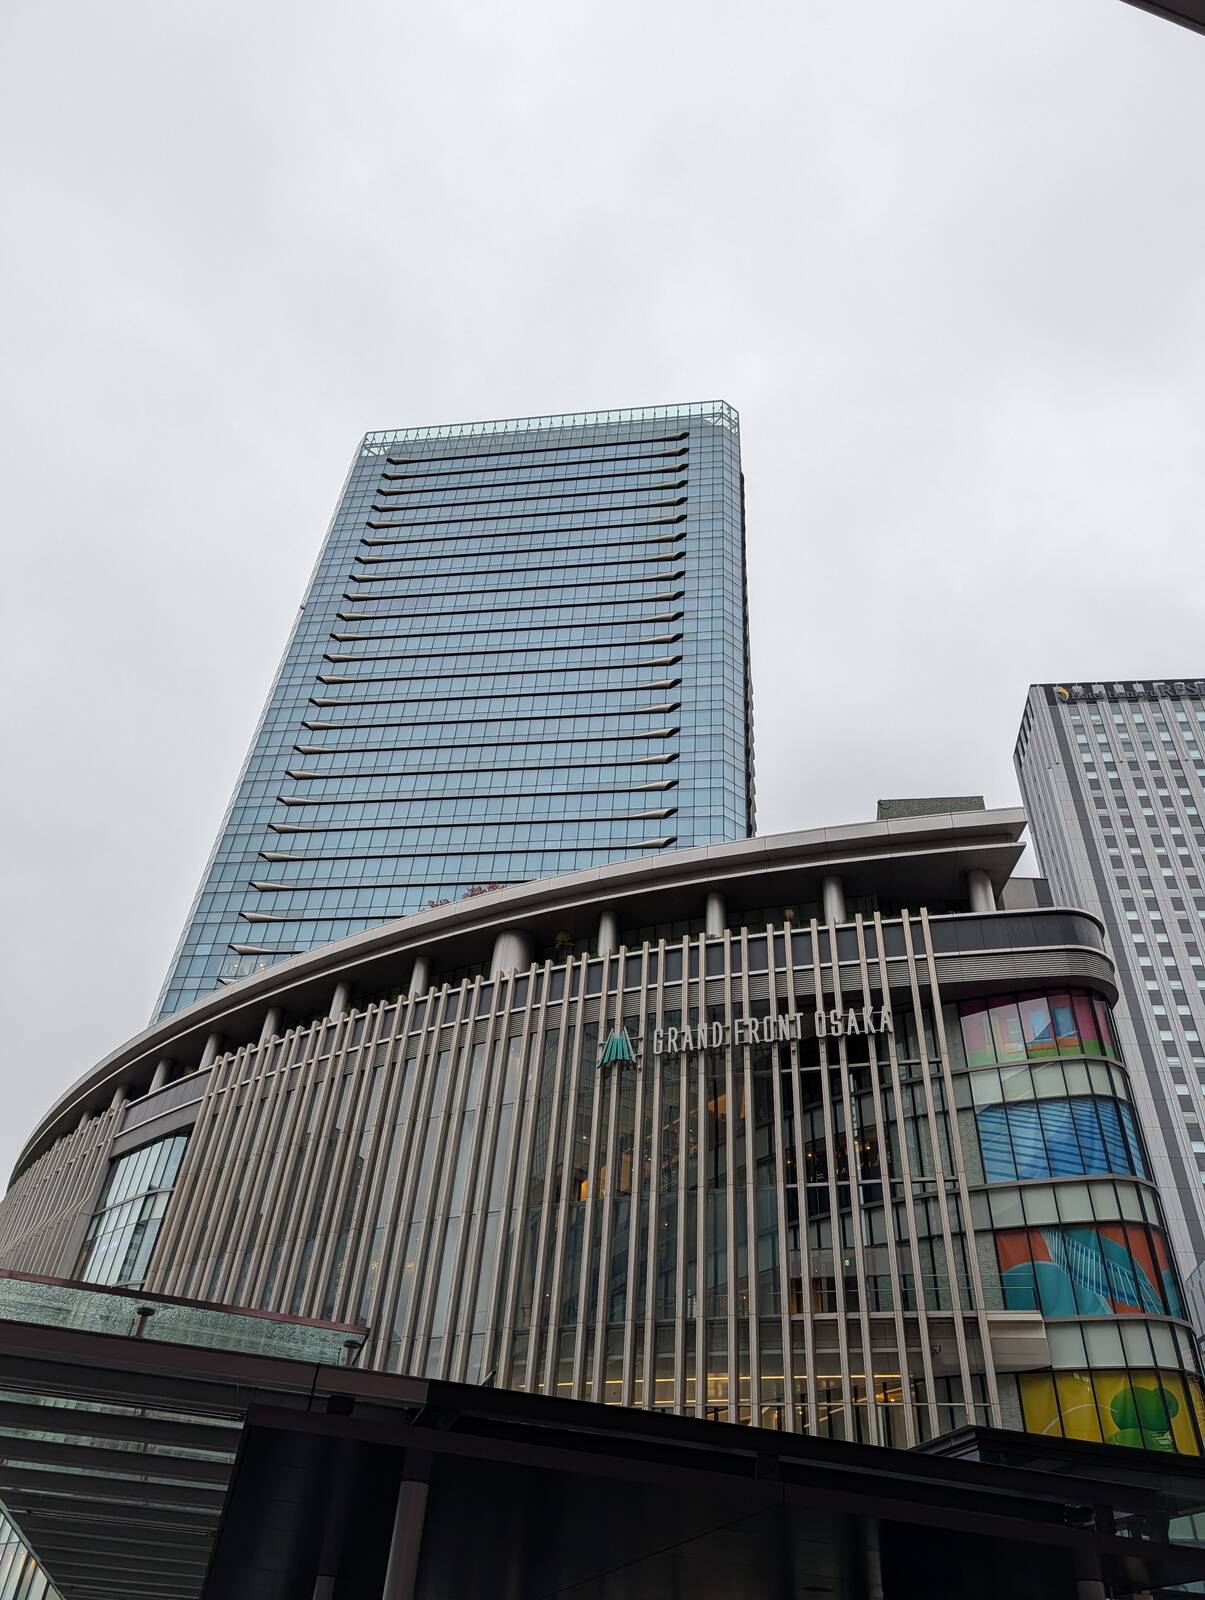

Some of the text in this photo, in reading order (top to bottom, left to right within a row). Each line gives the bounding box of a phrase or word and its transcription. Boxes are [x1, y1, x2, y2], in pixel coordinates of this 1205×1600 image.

[653, 1005, 894, 1054] GRAND FRONT OSAKA
